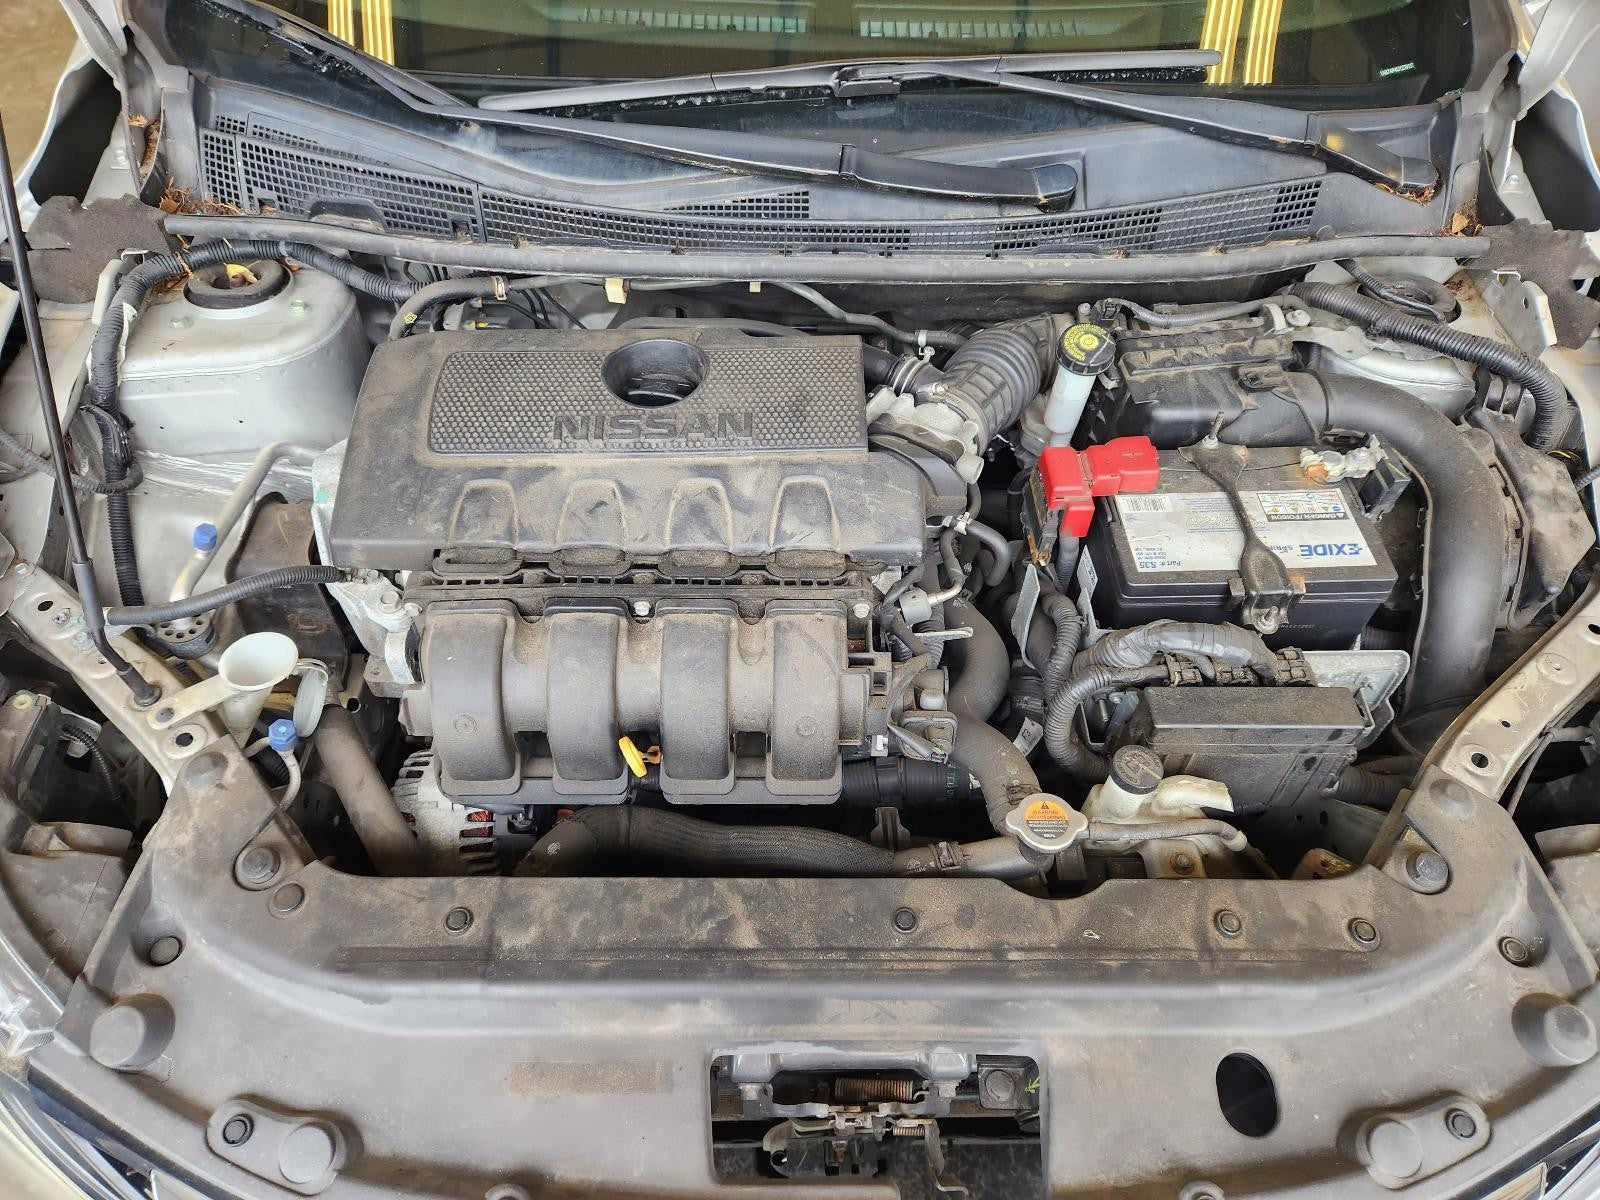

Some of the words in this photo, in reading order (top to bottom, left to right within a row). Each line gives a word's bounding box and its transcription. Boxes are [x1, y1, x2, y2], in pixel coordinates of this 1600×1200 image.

[553, 413, 754, 441] NISSAN
[1298, 543, 1363, 556] EXIDE
[1139, 561, 1157, 569] S35
